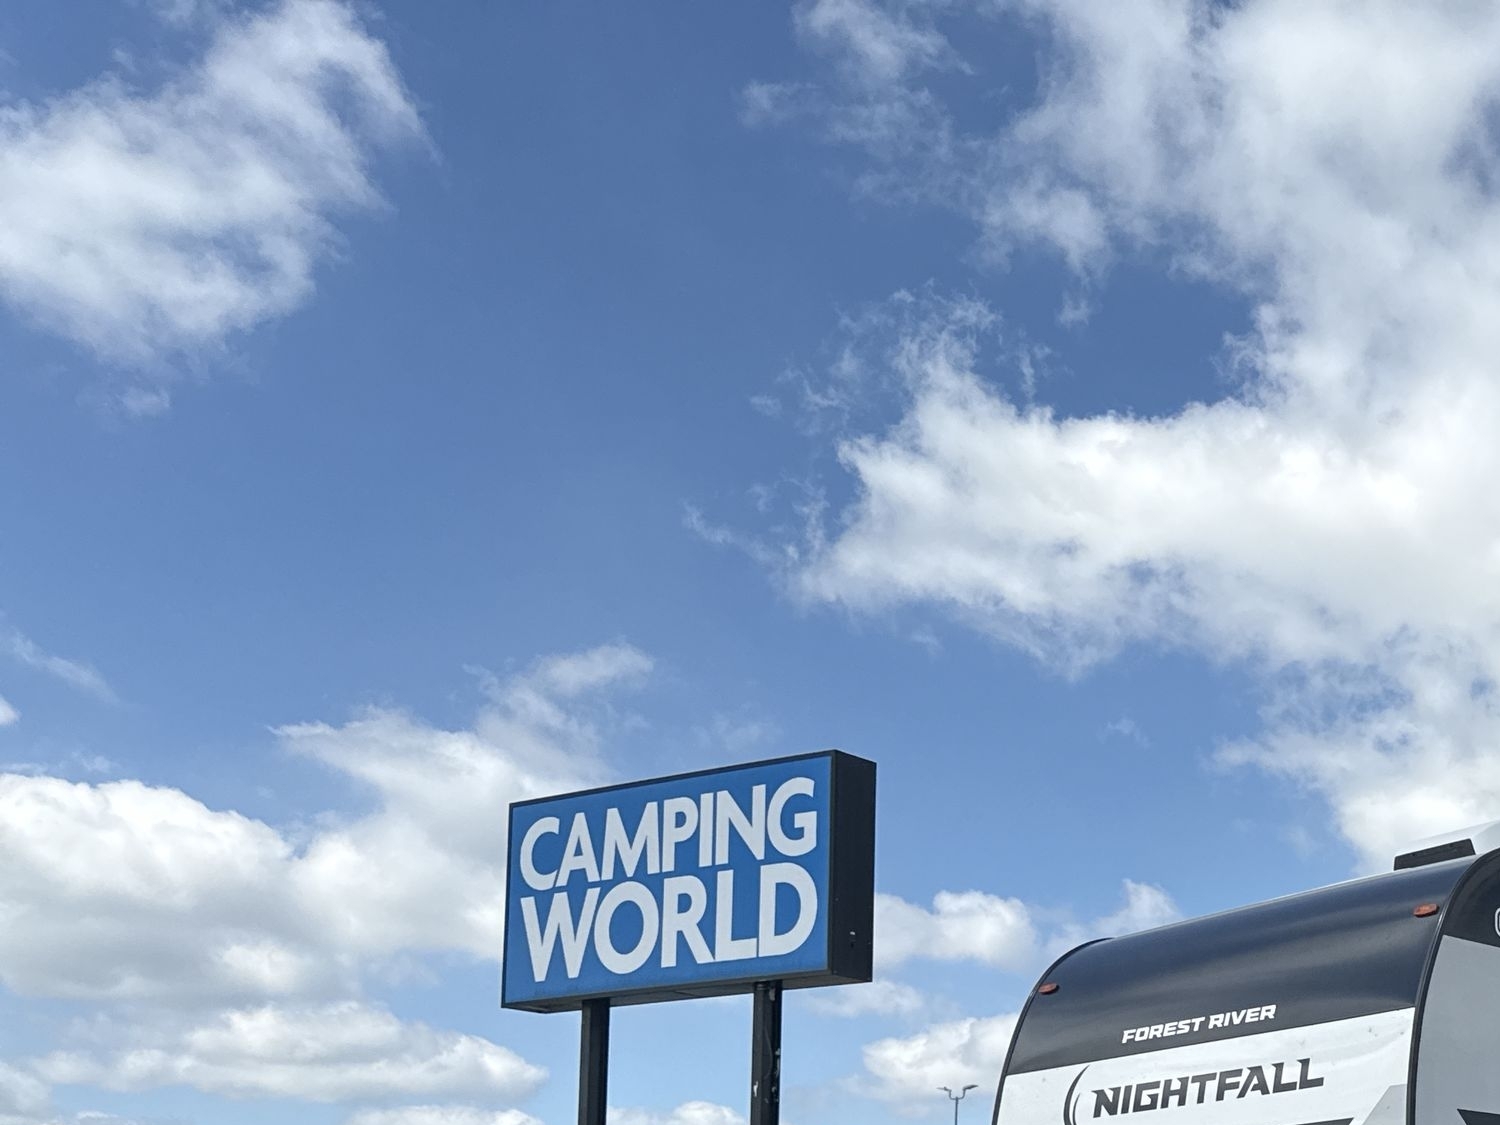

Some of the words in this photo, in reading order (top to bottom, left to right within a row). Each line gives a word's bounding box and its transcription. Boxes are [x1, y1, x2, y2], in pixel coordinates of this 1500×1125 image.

[519, 776, 818, 892] CAMPING
[519, 861, 819, 984] WORLD
[1121, 1016, 1206, 1044] FOREST
[1208, 1004, 1277, 1030] RIVER
[1091, 1057, 1325, 1119] NIGHTFALL
